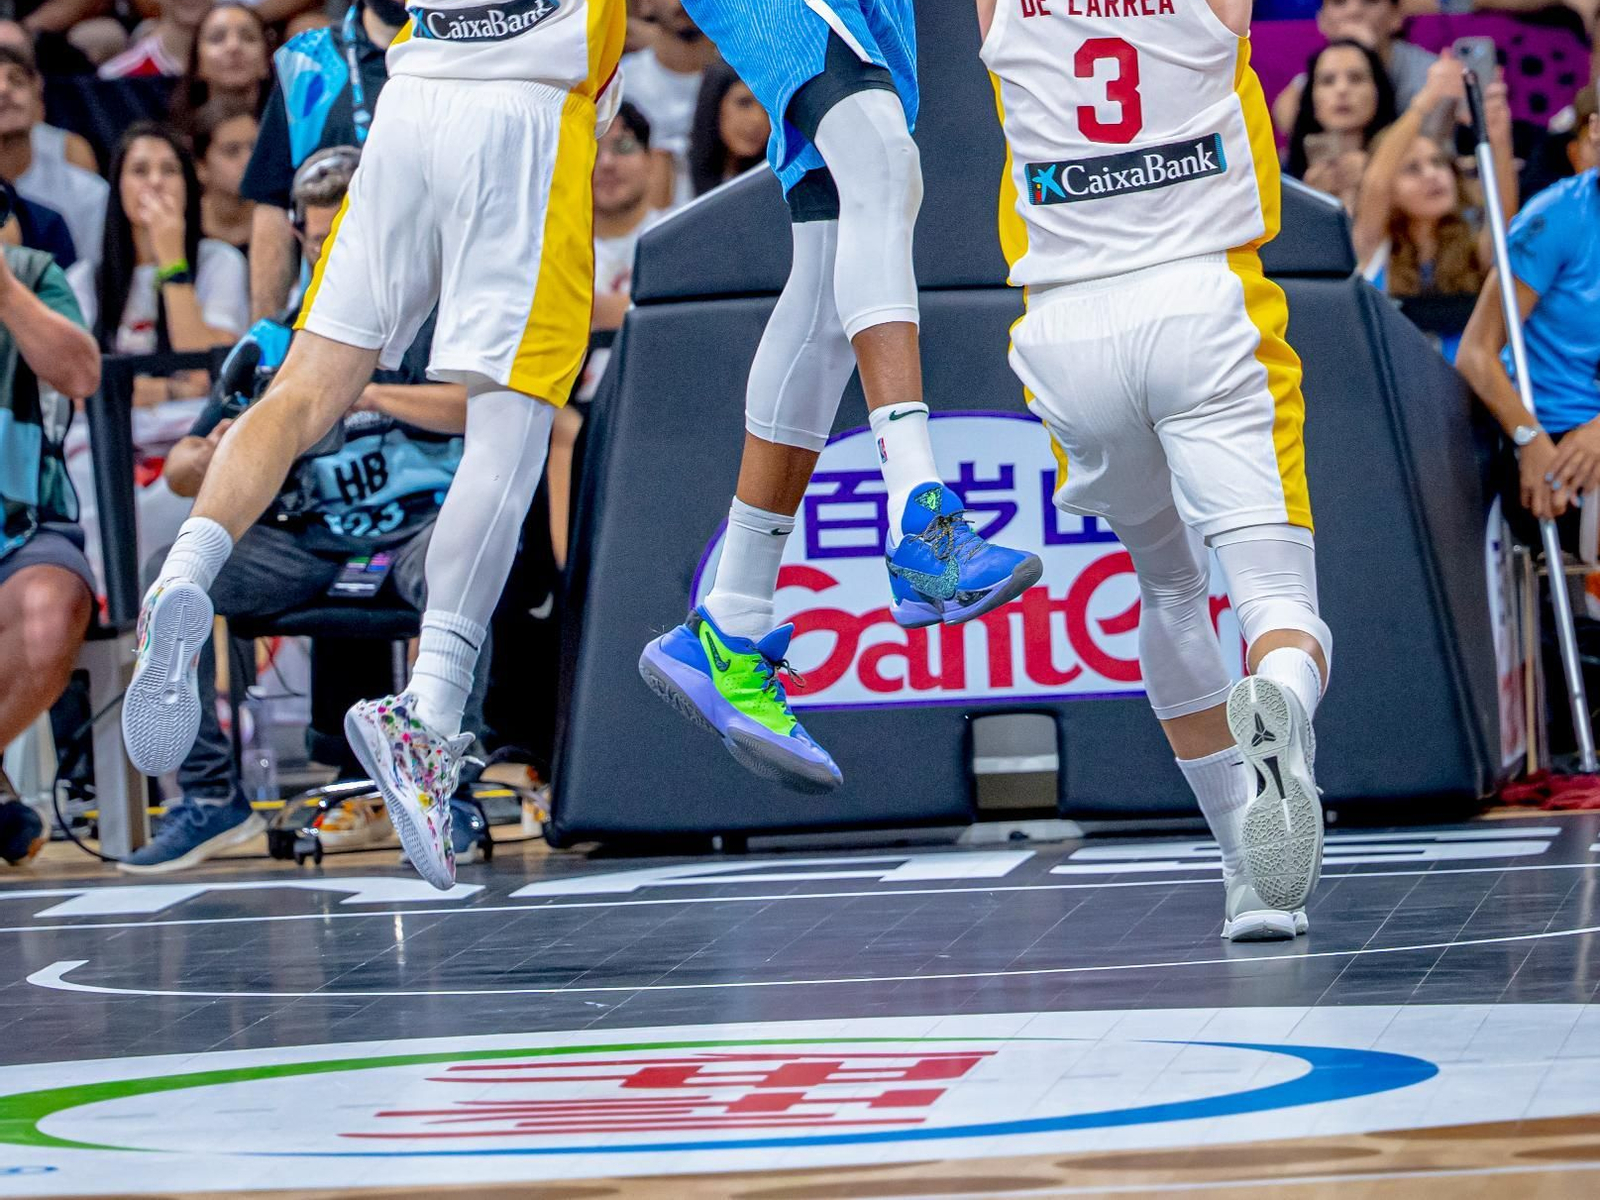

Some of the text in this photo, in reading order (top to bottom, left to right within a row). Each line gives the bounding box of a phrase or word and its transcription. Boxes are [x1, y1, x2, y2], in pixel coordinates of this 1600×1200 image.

[1074, 37, 1143, 144] 3
[1061, 142, 1218, 196] CaixaBank
[334, 451, 388, 506] HB
